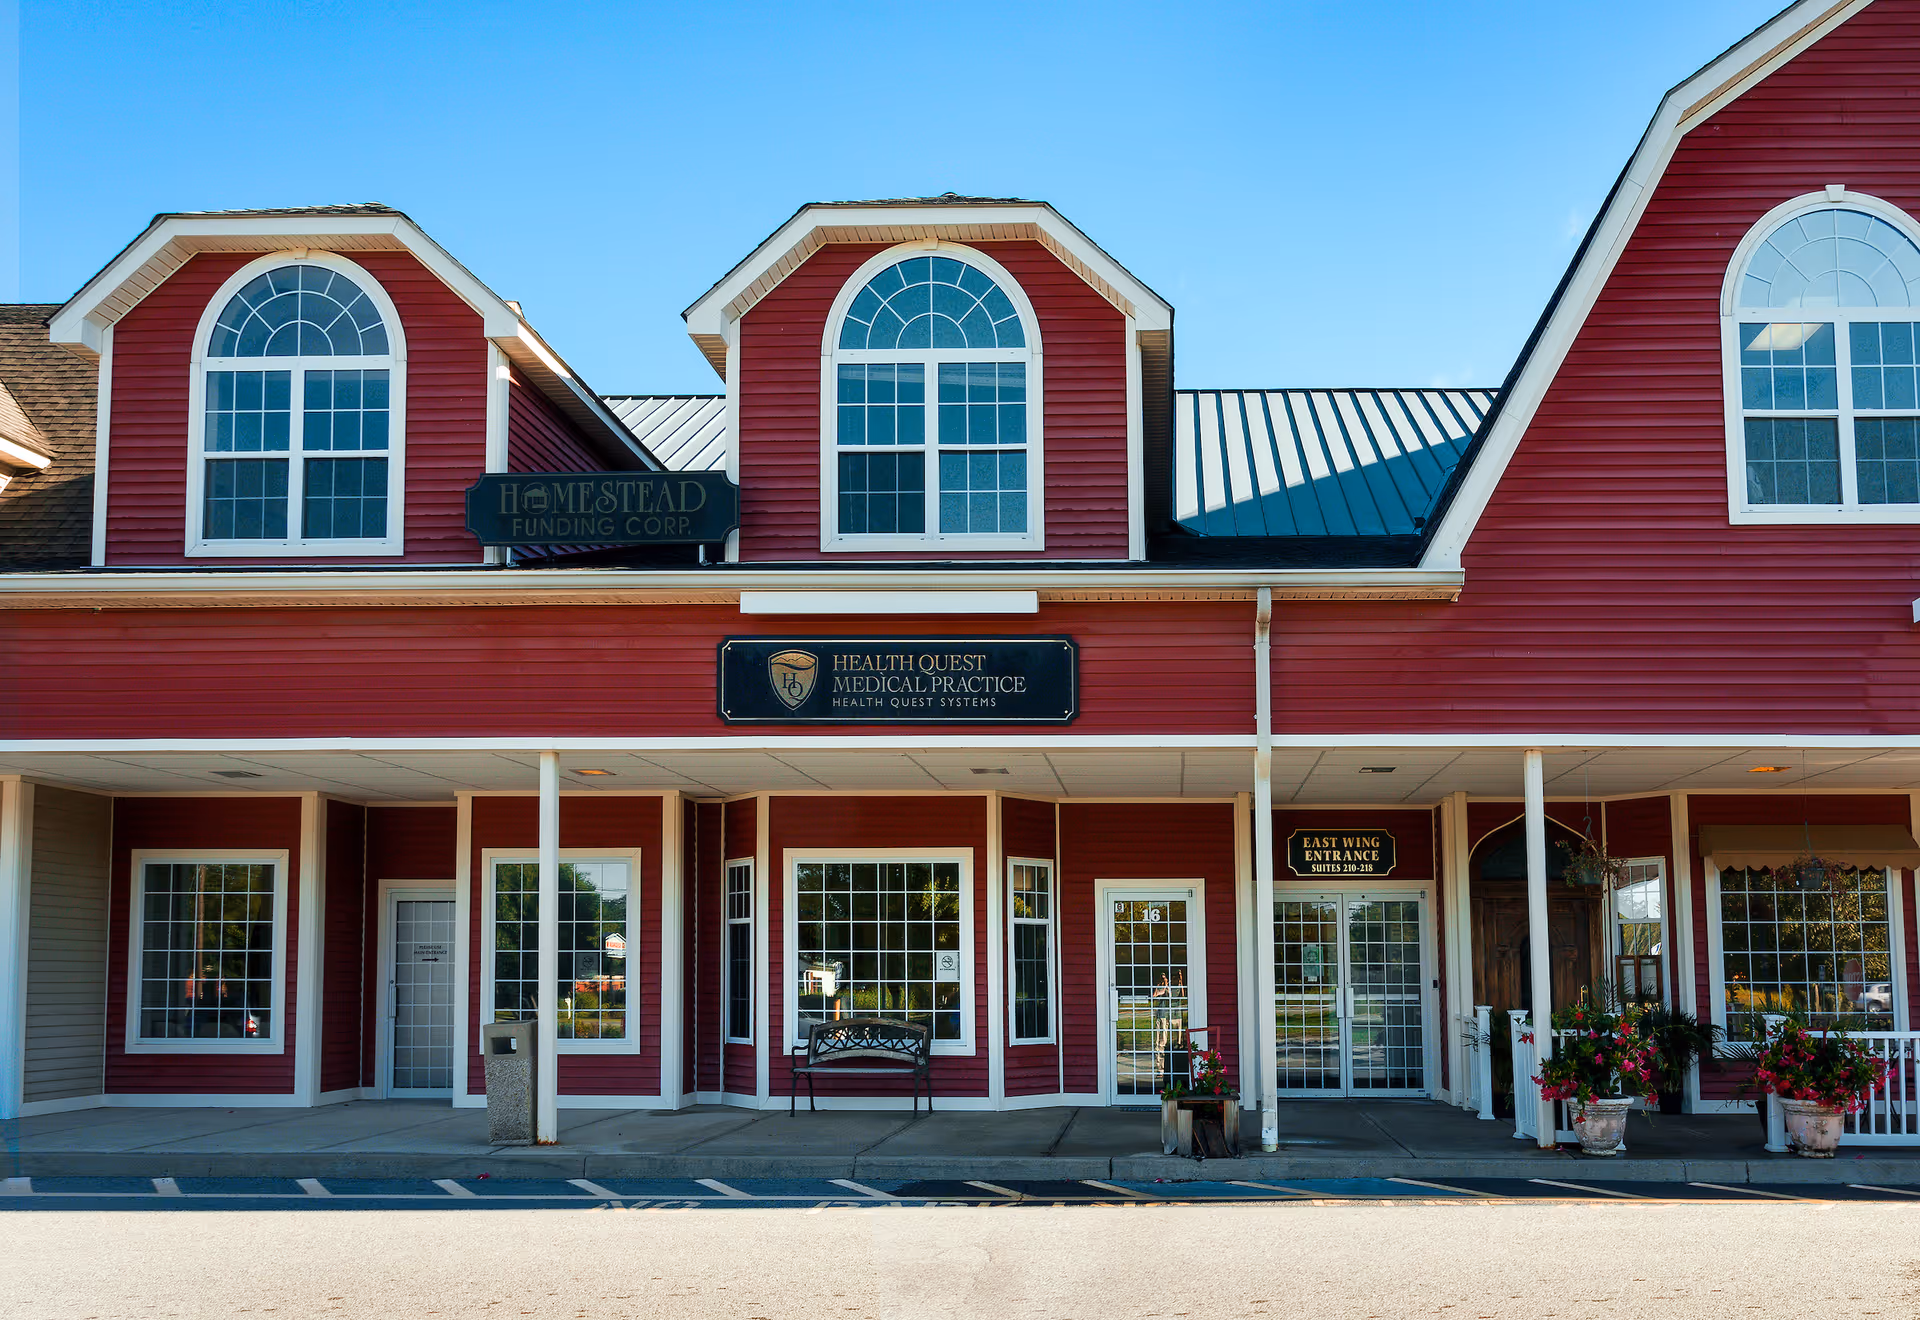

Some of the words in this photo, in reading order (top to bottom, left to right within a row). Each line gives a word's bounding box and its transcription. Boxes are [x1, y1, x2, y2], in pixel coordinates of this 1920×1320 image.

[497, 480, 707, 515] HOMESTEAD
[512, 517, 615, 537] FUNDING
[625, 516, 692, 536] CORP.
[832, 654, 914, 671] HEALTH
[918, 654, 986, 675] QUEST
[832, 675, 927, 693] MEDICAL
[931, 675, 1027, 693] PRACTICE
[832, 697, 883, 707] HEALTH
[890, 697, 933, 709] QUEST
[940, 697, 996, 707] SYSTEMS
[1303, 837, 1338, 848] EAST
[1342, 837, 1380, 848] WING
[1305, 850, 1380, 861] ENTRANCE
[1311, 863, 1341, 872] SUITES
[1343, 863, 1374, 872] 210-218
[1142, 909, 1160, 921] 16
